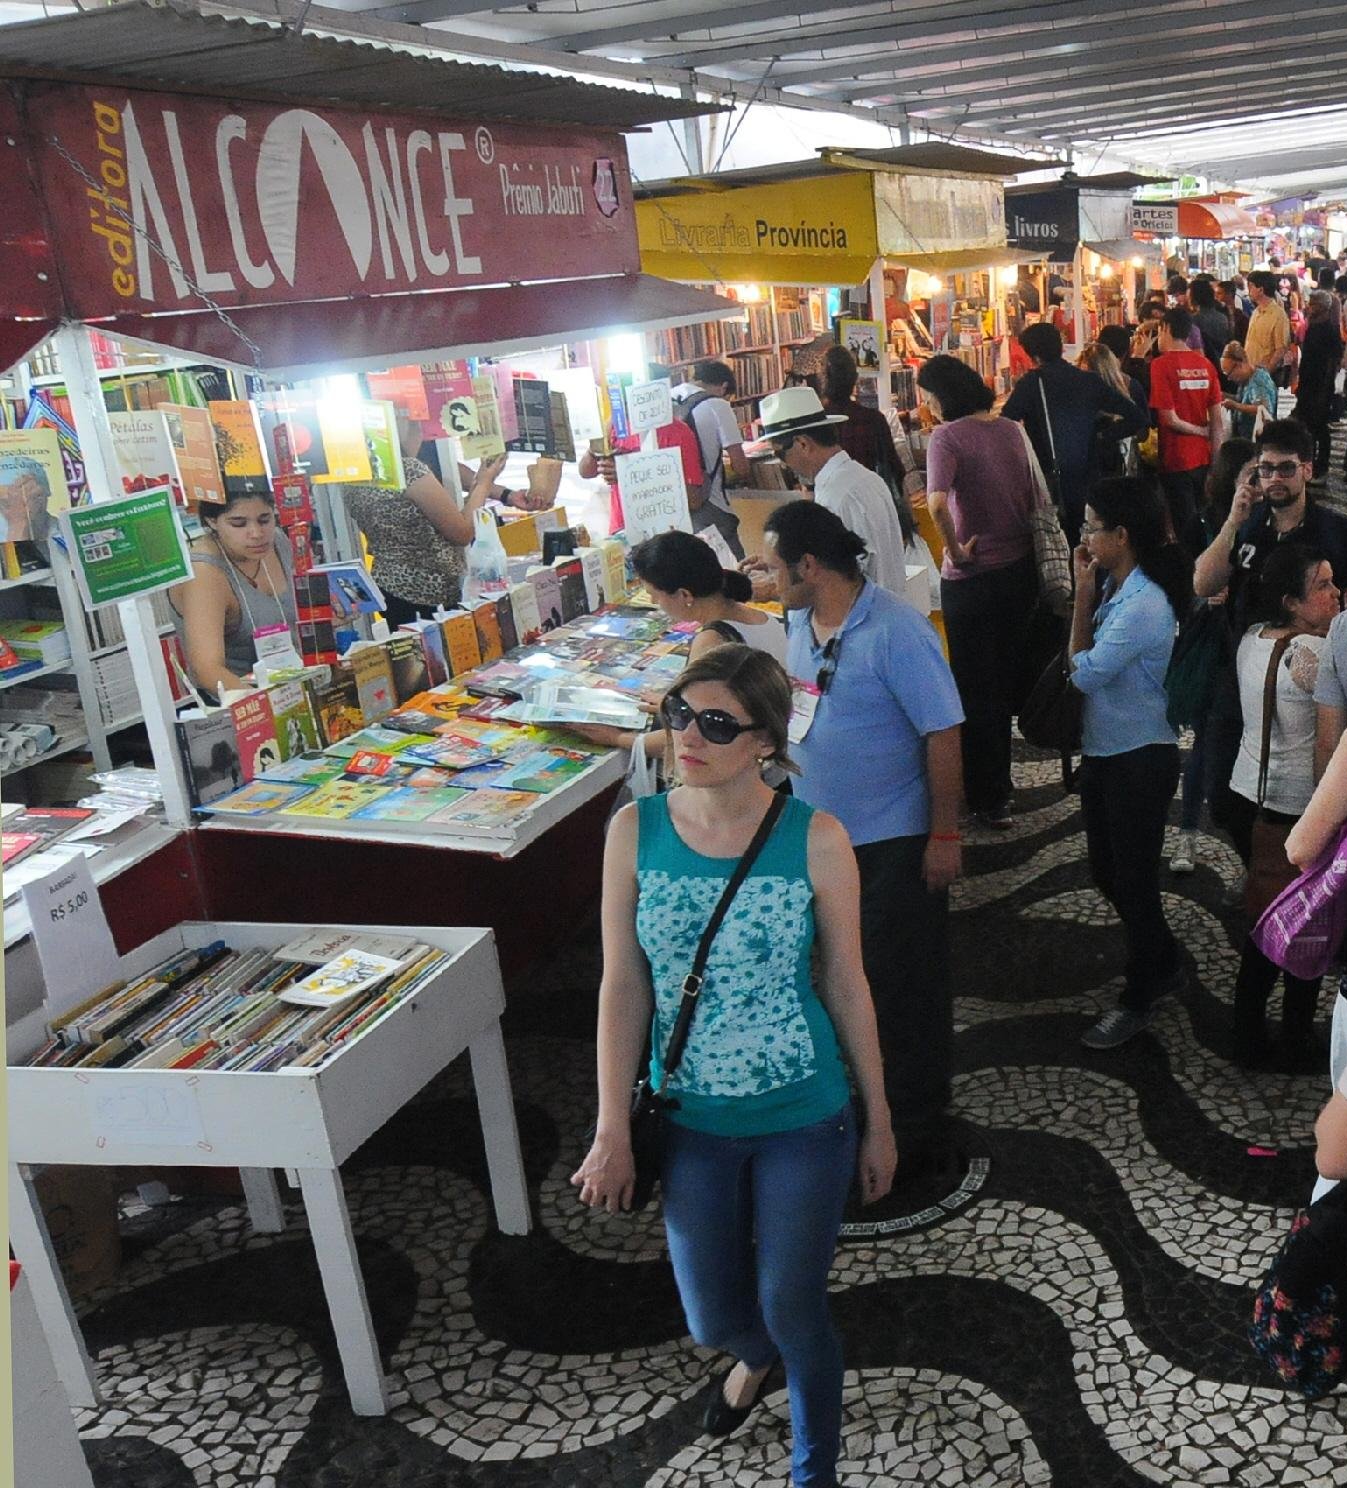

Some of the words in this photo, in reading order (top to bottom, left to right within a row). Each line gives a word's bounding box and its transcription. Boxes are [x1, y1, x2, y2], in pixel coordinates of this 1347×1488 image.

[93, 100, 135, 297] editora
[499, 162, 543, 216] Prêmio
[544, 164, 585, 216] Jabuti
[659, 217, 750, 248] Livraria
[755, 219, 848, 249] Província
[1014, 215, 1059, 238] livros
[50, 904, 66, 922] R$
[67, 890, 88, 914] 5,00
